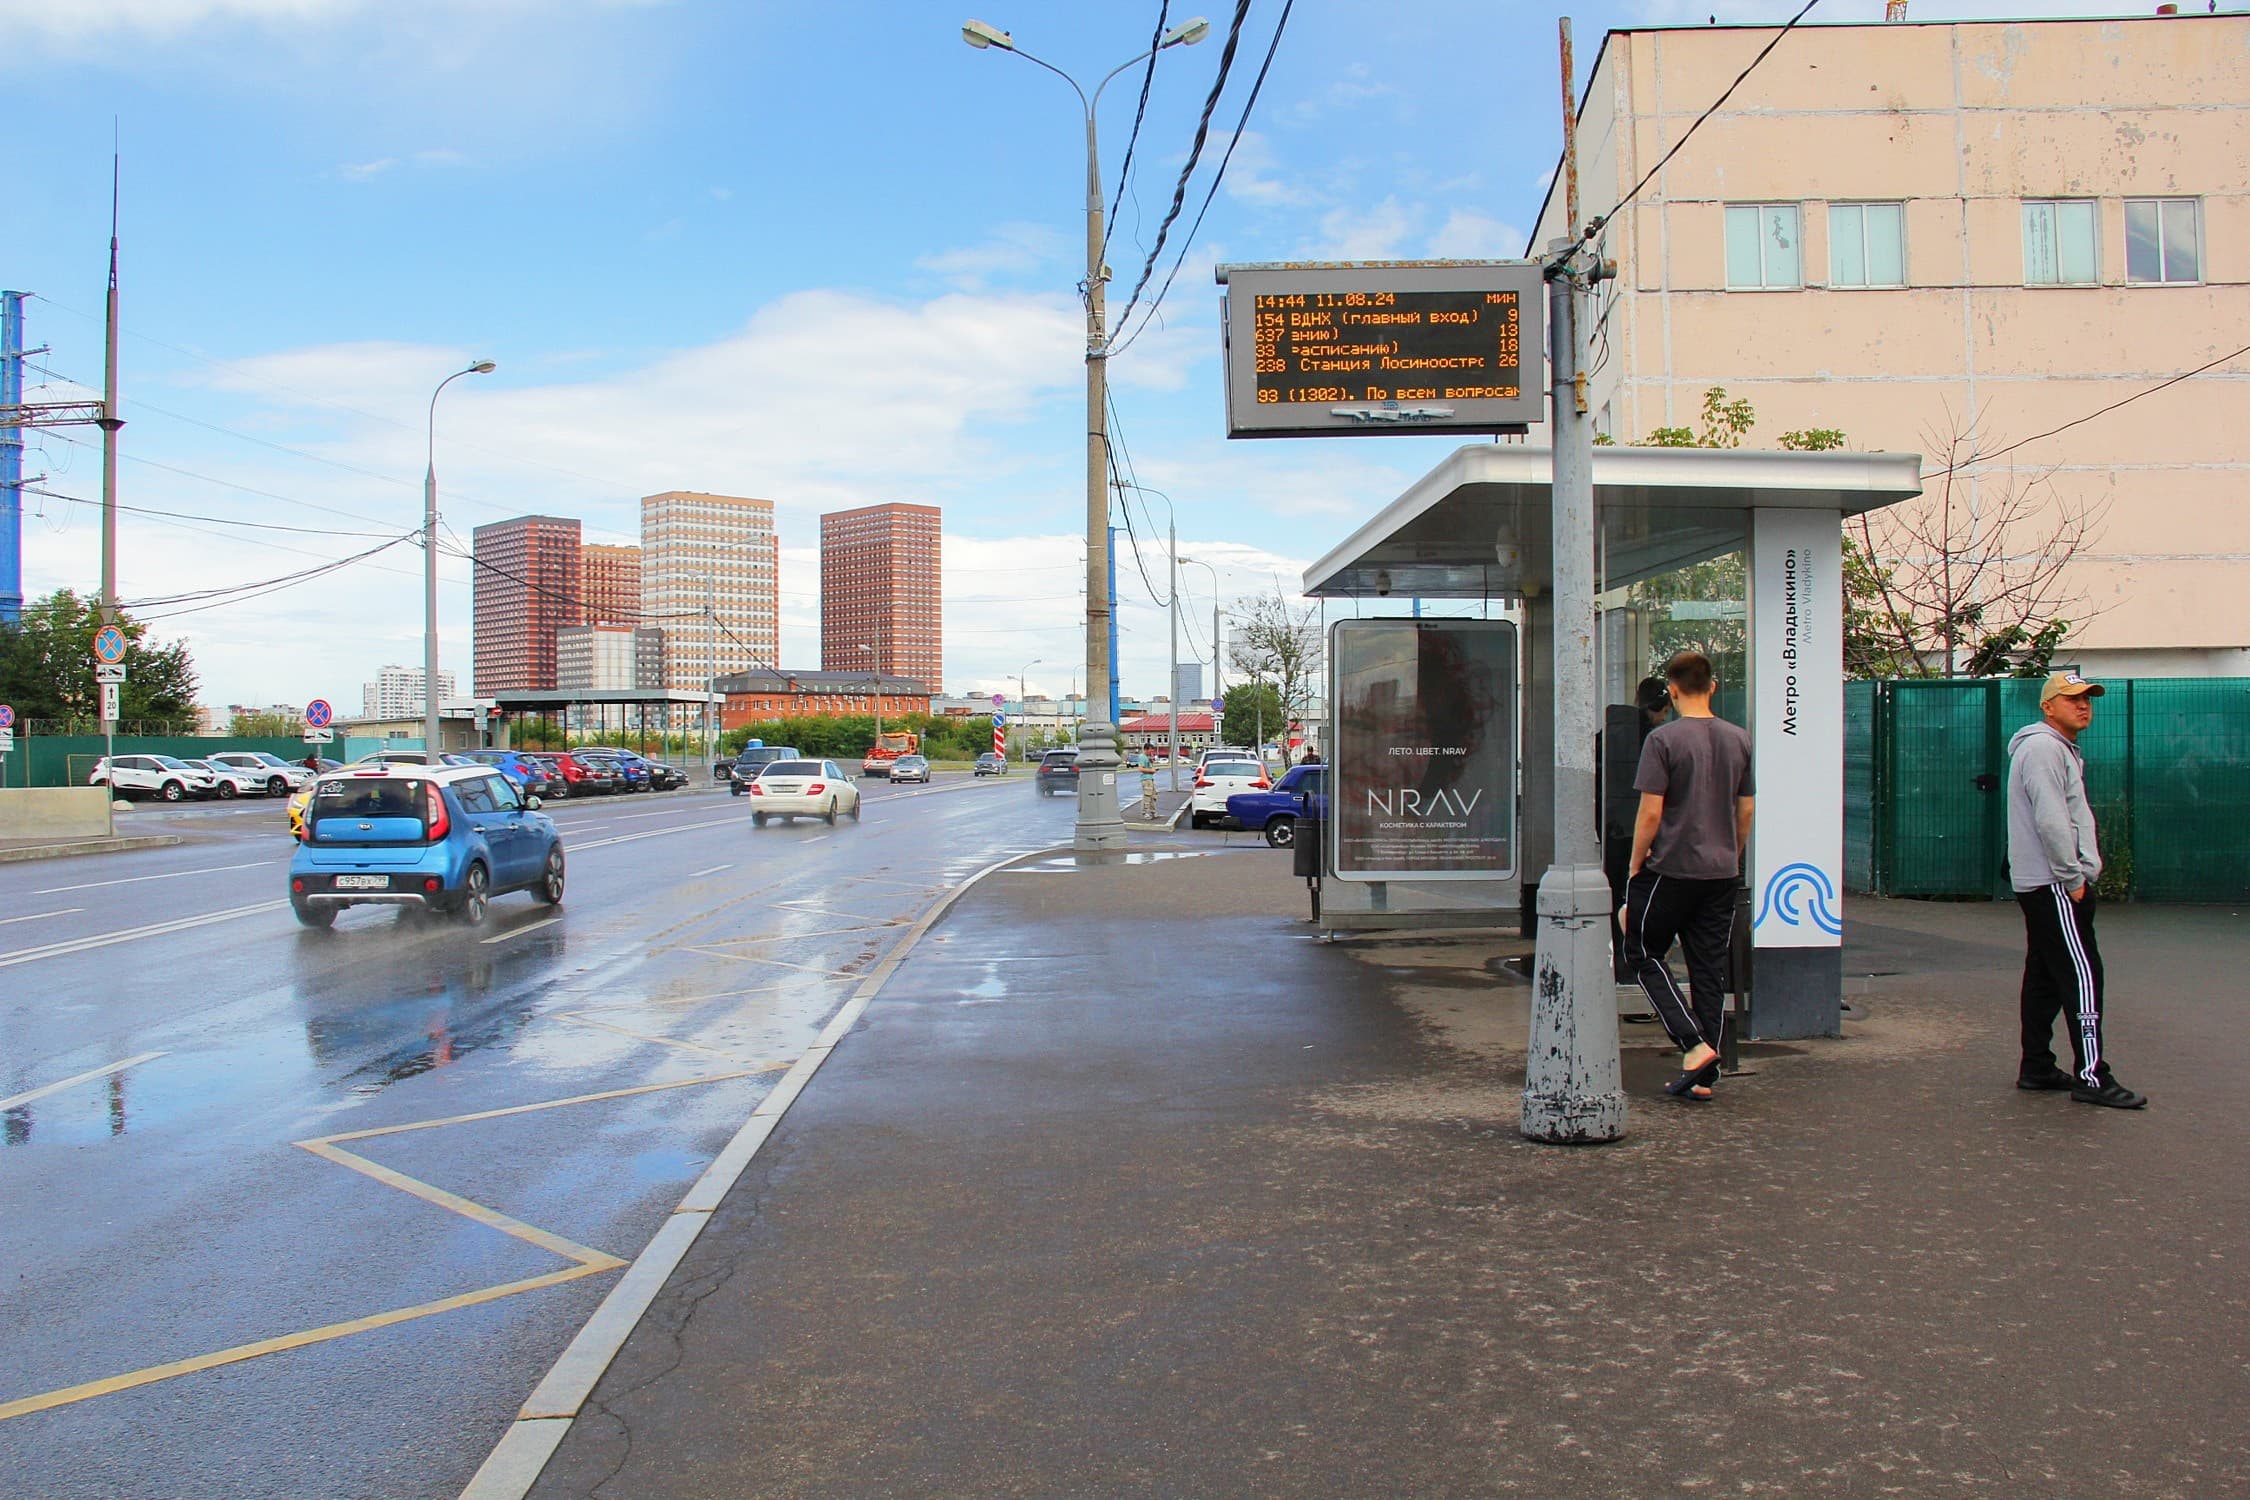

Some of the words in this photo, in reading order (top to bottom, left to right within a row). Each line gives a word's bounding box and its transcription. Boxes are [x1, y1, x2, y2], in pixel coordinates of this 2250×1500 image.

[1256, 295, 1306, 308] 14:44
[1317, 293, 1396, 307] 11.08.24
[1256, 314, 1285, 327] 154
[1291, 312, 1332, 327] ВДНХ
[1342, 311, 1421, 325] (главный
[1430, 309, 1478, 325] вход)
[1508, 309, 1518, 322] 9
[1255, 329, 1285, 342] 637
[1500, 324, 1518, 337] 13
[1256, 344, 1275, 357] 33
[1500, 339, 1518, 352] 18
[1256, 359, 1287, 372] 238
[1300, 358, 1370, 371] Станция
[1499, 354, 1518, 367] 26
[1258, 389, 1278, 403] 93
[1289, 387, 1355, 402] (1302).
[1367, 387, 1386, 400] По
[1397, 388, 1436, 399] всем
[1802, 548, 1814, 605] Vladykino
[1783, 549, 1799, 670] «Владыкино»
[1802, 609, 1812, 644] Metro
[107, 701, 116, 709] 20
[1783, 675, 1799, 736] Метро
[1388, 747, 1414, 756] ЛЕТО.
[1416, 747, 1441, 757] ЦВЕТ.
[1443, 747, 1467, 756] NRAV
[1368, 788, 1483, 816] NRAV
[1425, 821, 1467, 829] ХАРАКТЕРОМ
